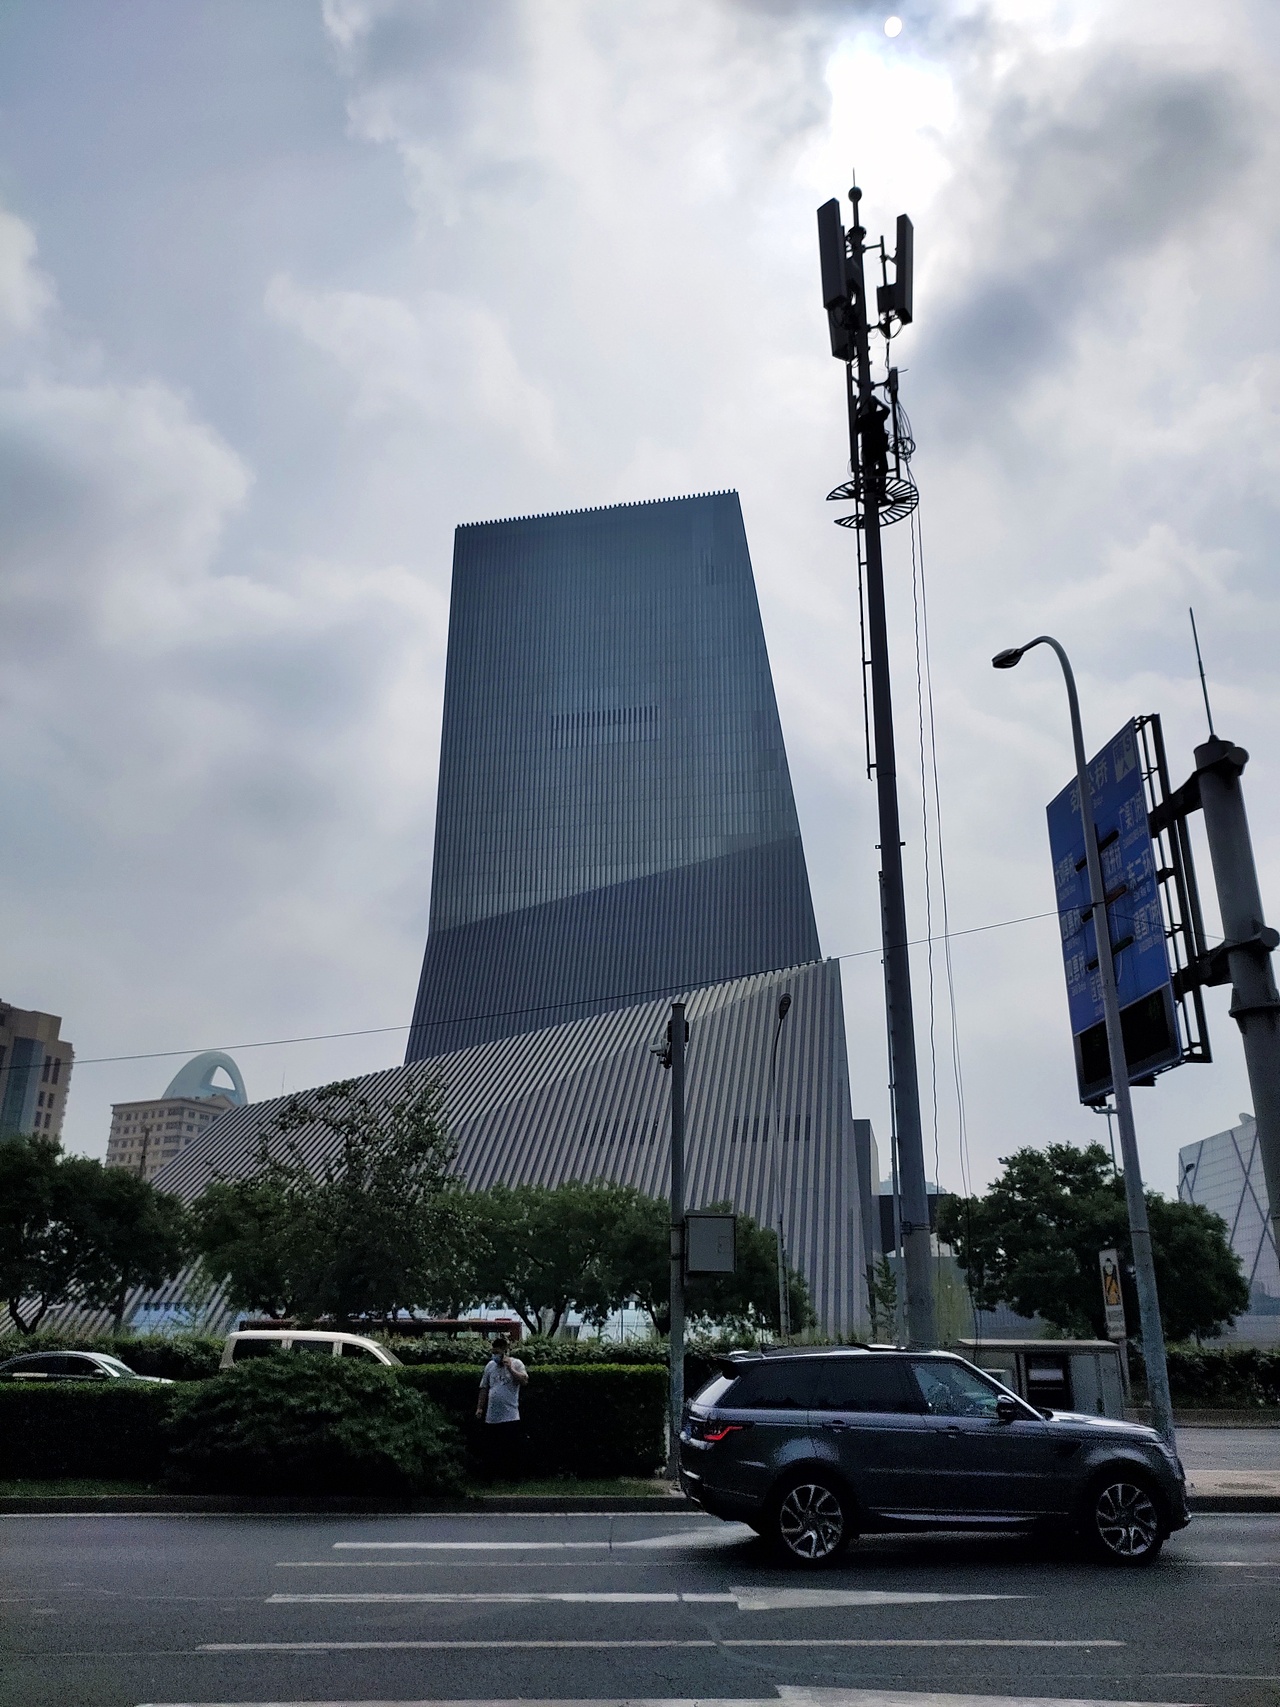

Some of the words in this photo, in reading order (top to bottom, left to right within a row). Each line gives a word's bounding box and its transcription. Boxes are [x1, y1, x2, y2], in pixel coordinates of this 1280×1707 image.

[1124, 732, 1132, 752] S
[1126, 846, 1152, 891] 东二环
[1133, 897, 1159, 941] 建国门桥
